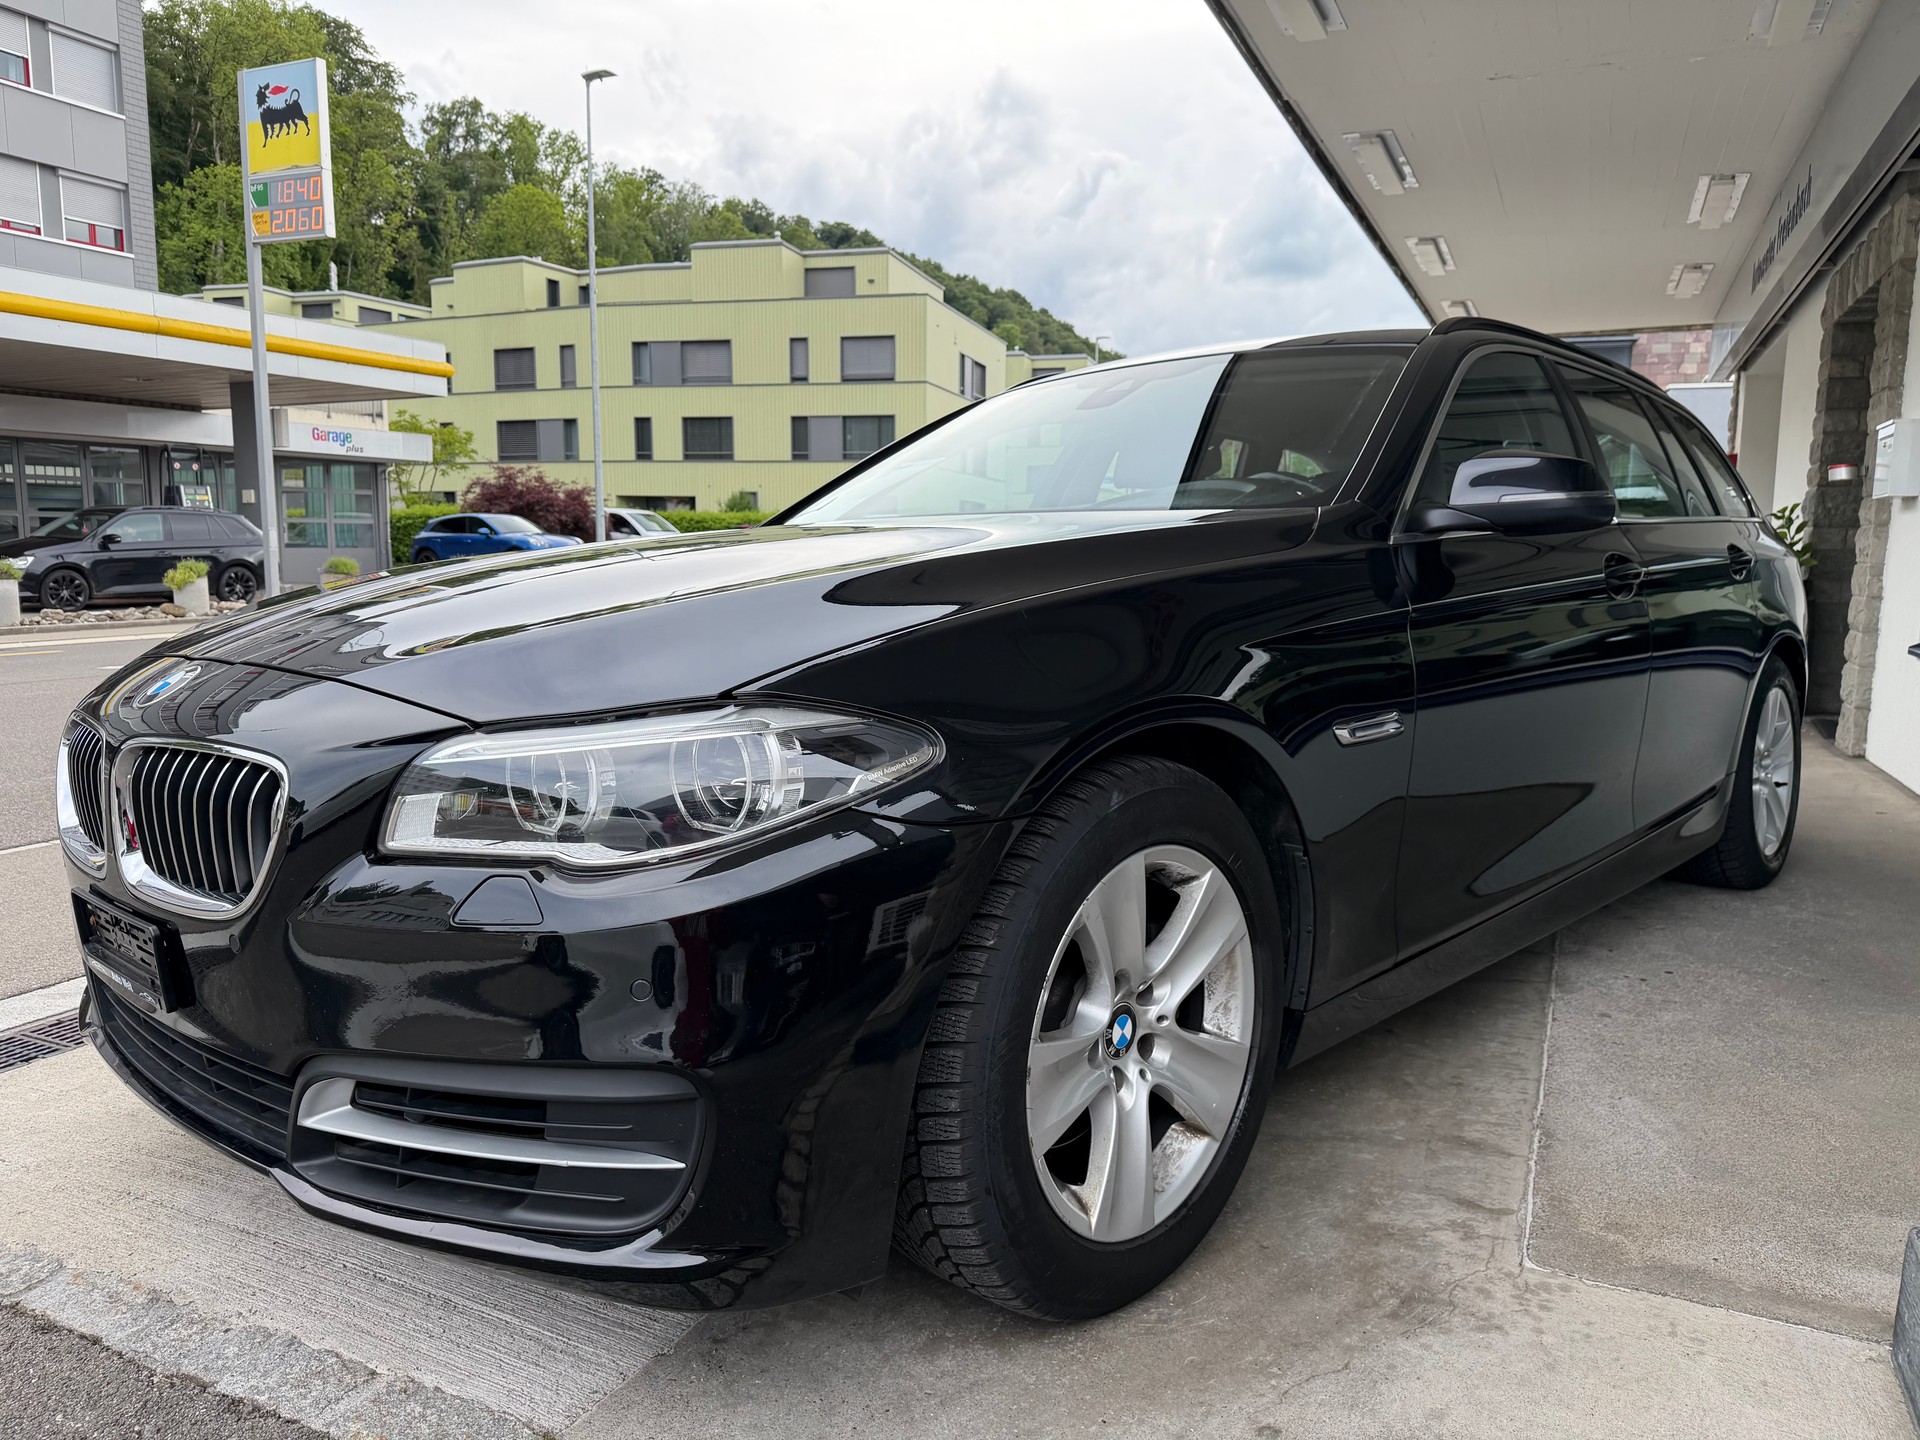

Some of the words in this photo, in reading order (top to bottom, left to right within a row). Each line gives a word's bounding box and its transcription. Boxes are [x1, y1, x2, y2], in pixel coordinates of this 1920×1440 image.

[272, 206, 324, 233] 2.060
[312, 427, 352, 447] Garage
[346, 444, 364, 454] plus
[867, 770, 884, 781] BMW
[883, 762, 907, 775] Adaptive
[905, 756, 918, 766] LED
[1105, 1028, 1126, 1057] BMW
